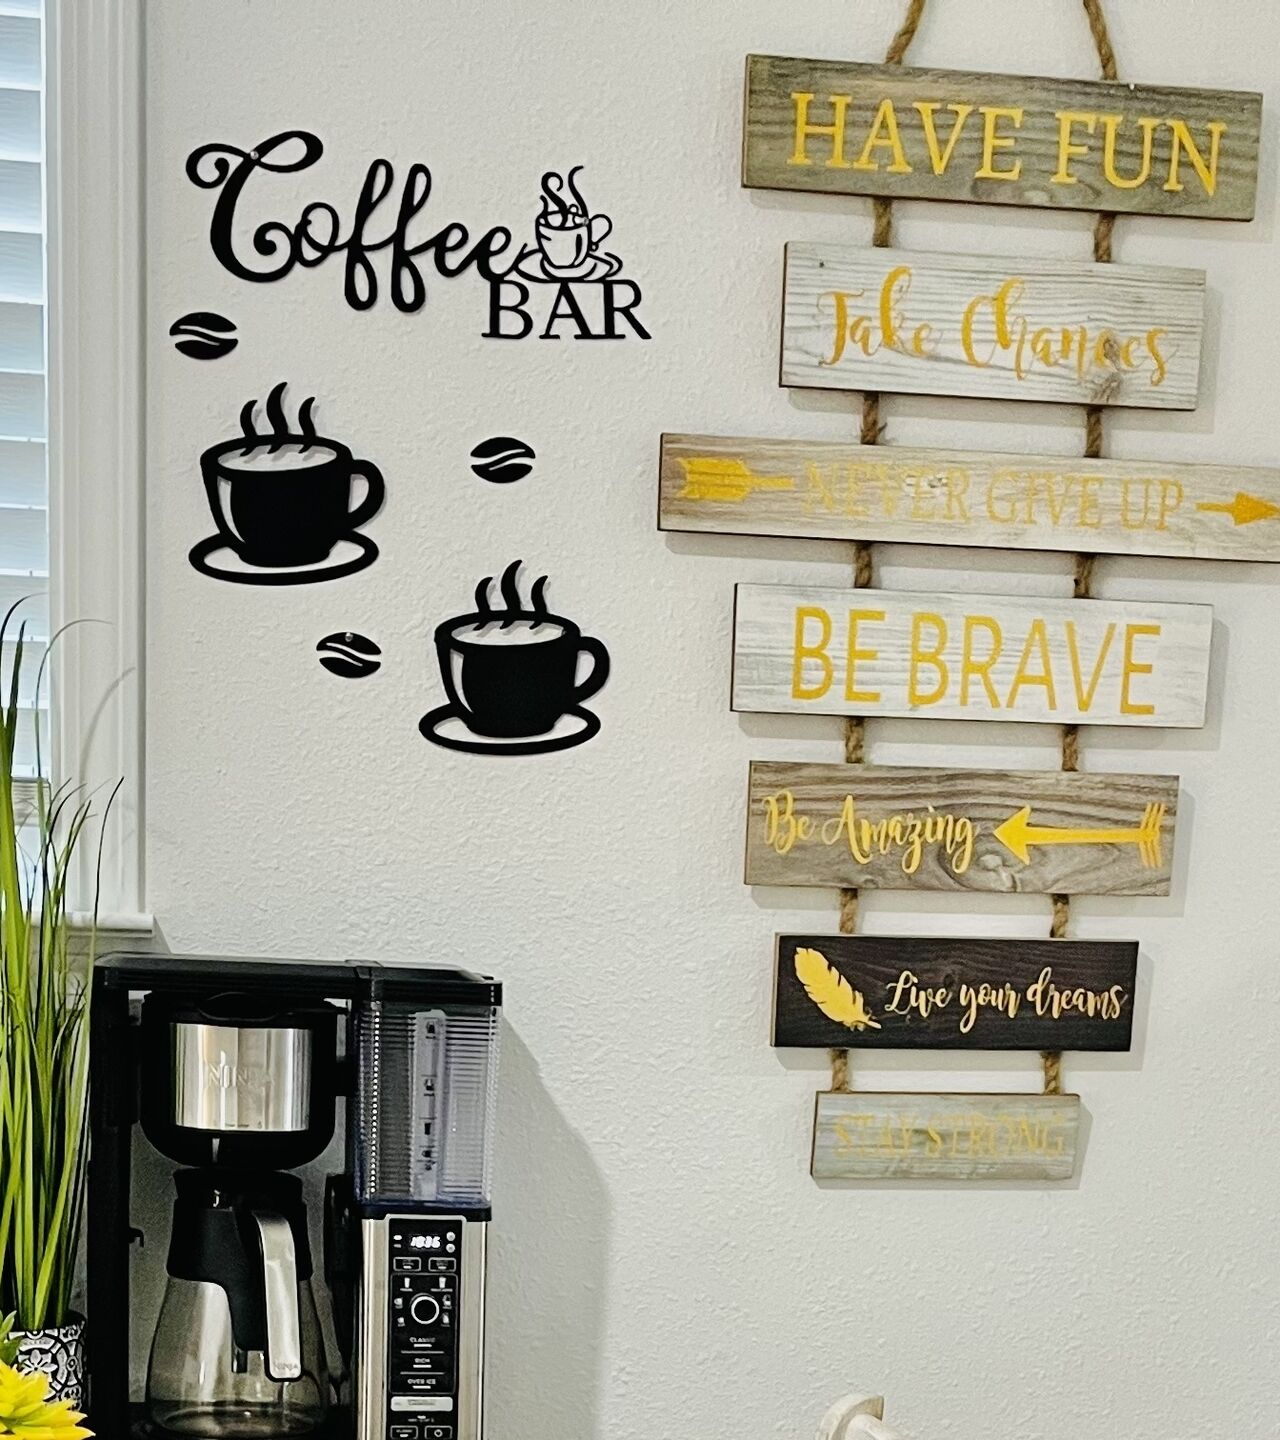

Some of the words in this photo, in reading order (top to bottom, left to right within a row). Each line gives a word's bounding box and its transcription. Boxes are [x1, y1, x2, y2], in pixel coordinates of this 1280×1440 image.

[786, 90, 1022, 181] HAVE
[1049, 110, 1227, 197] FUN
[185, 129, 512, 313] Coffee
[481, 279, 652, 340] BAR
[818, 265, 940, 367] Take
[961, 277, 1180, 386] Chances
[803, 457, 973, 524] NEVER
[985, 473, 1104, 530] GIVE
[1119, 478, 1185, 532] UP
[790, 606, 886, 702] BE
[906, 611, 1162, 715] BRAVE
[761, 789, 814, 855] Be
[822, 794, 978, 874] Amazing
[884, 969, 951, 1017] Live
[958, 982, 1021, 1033] your
[1025, 966, 1128, 1020] dreams
